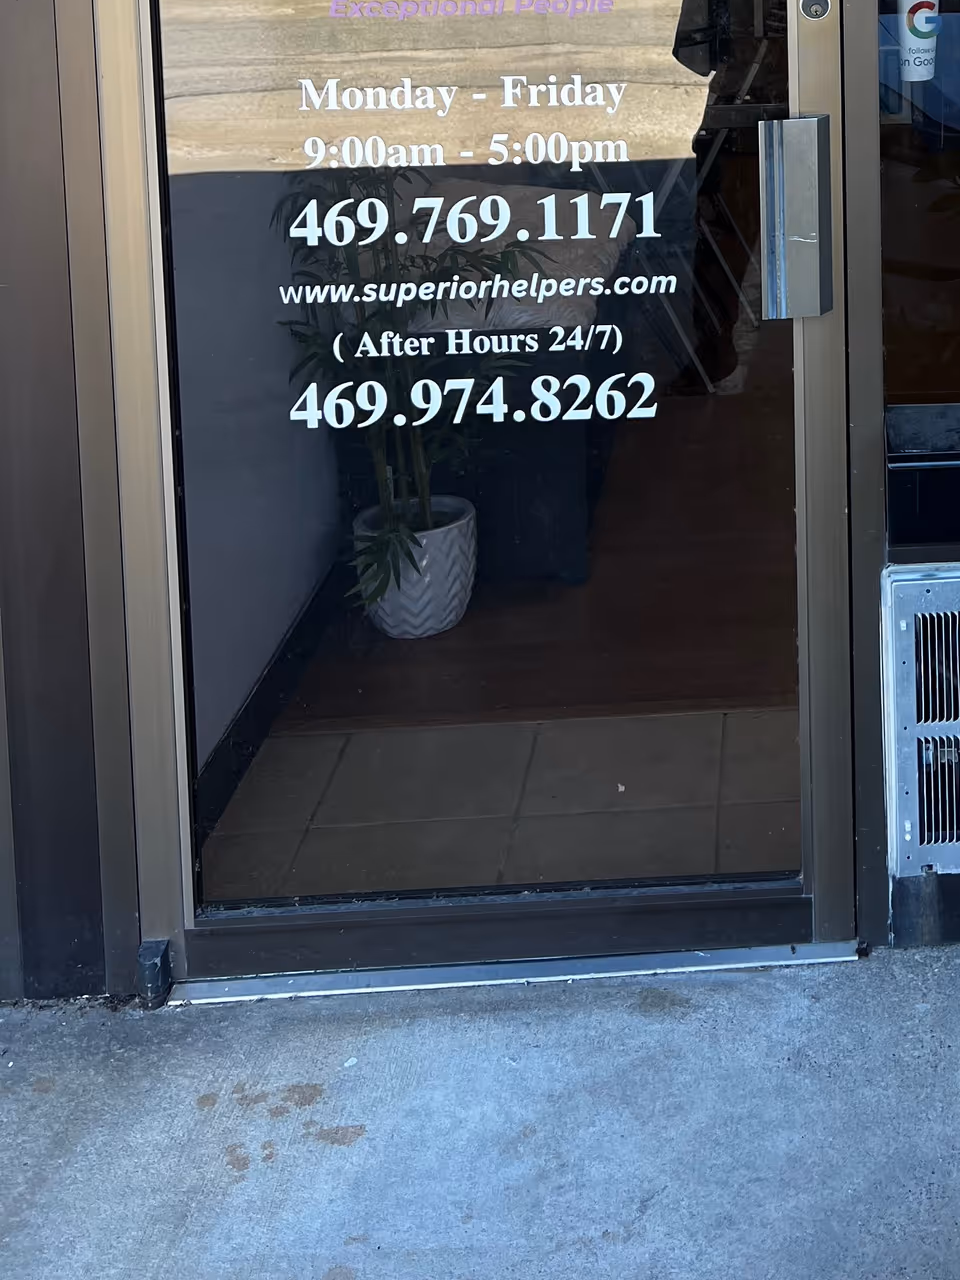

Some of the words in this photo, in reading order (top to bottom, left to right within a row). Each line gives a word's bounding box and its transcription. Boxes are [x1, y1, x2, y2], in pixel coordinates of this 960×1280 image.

[298, 78, 458, 116] Monday
[500, 74, 628, 114] Friday
[304, 135, 446, 169] 9:00am
[488, 132, 630, 172] 5:00pm
[289, 191, 662, 247] 469.769.1171
[279, 272, 677, 307] www.superiorhelpers.com
[354, 331, 435, 359] After
[445, 328, 539, 354] Hours
[549, 324, 623, 355] 24/7)
[289, 372, 659, 430] 469.974.8262
